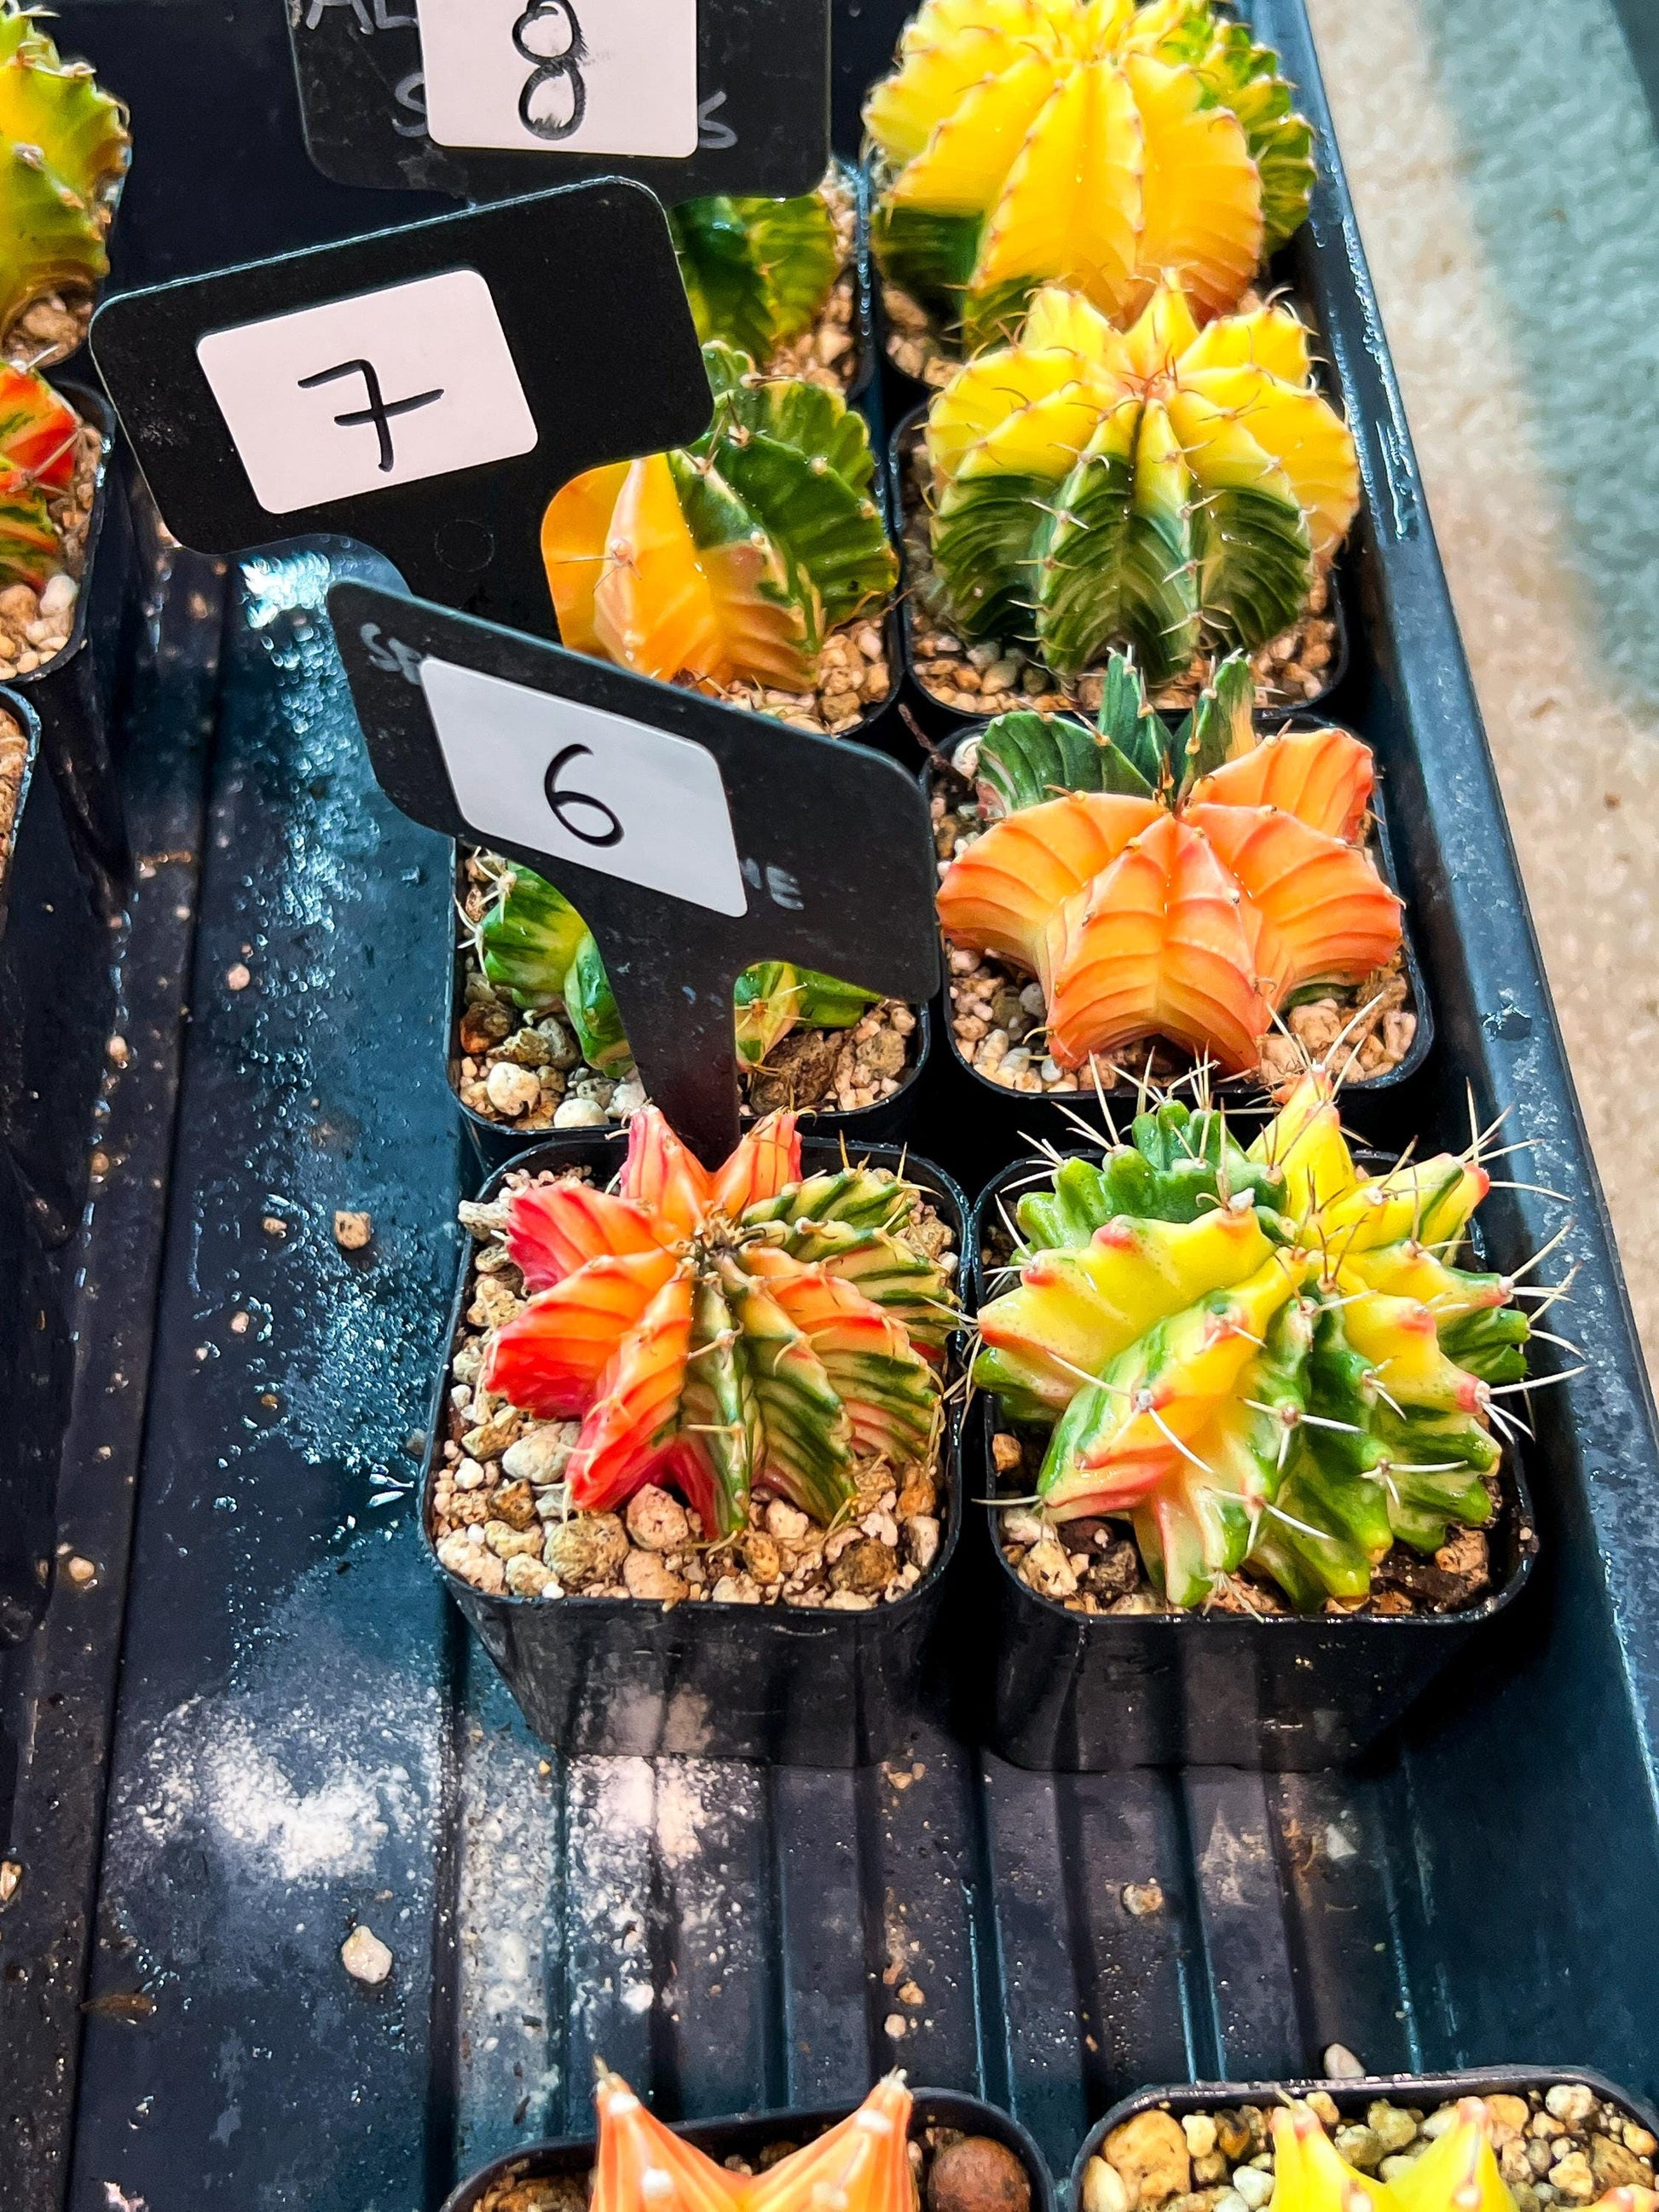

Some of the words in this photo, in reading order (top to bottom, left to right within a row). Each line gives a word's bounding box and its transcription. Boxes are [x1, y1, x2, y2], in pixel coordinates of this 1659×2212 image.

[512, 0, 589, 140] 8
[297, 358, 445, 473] 7
[543, 742, 624, 847] 6
